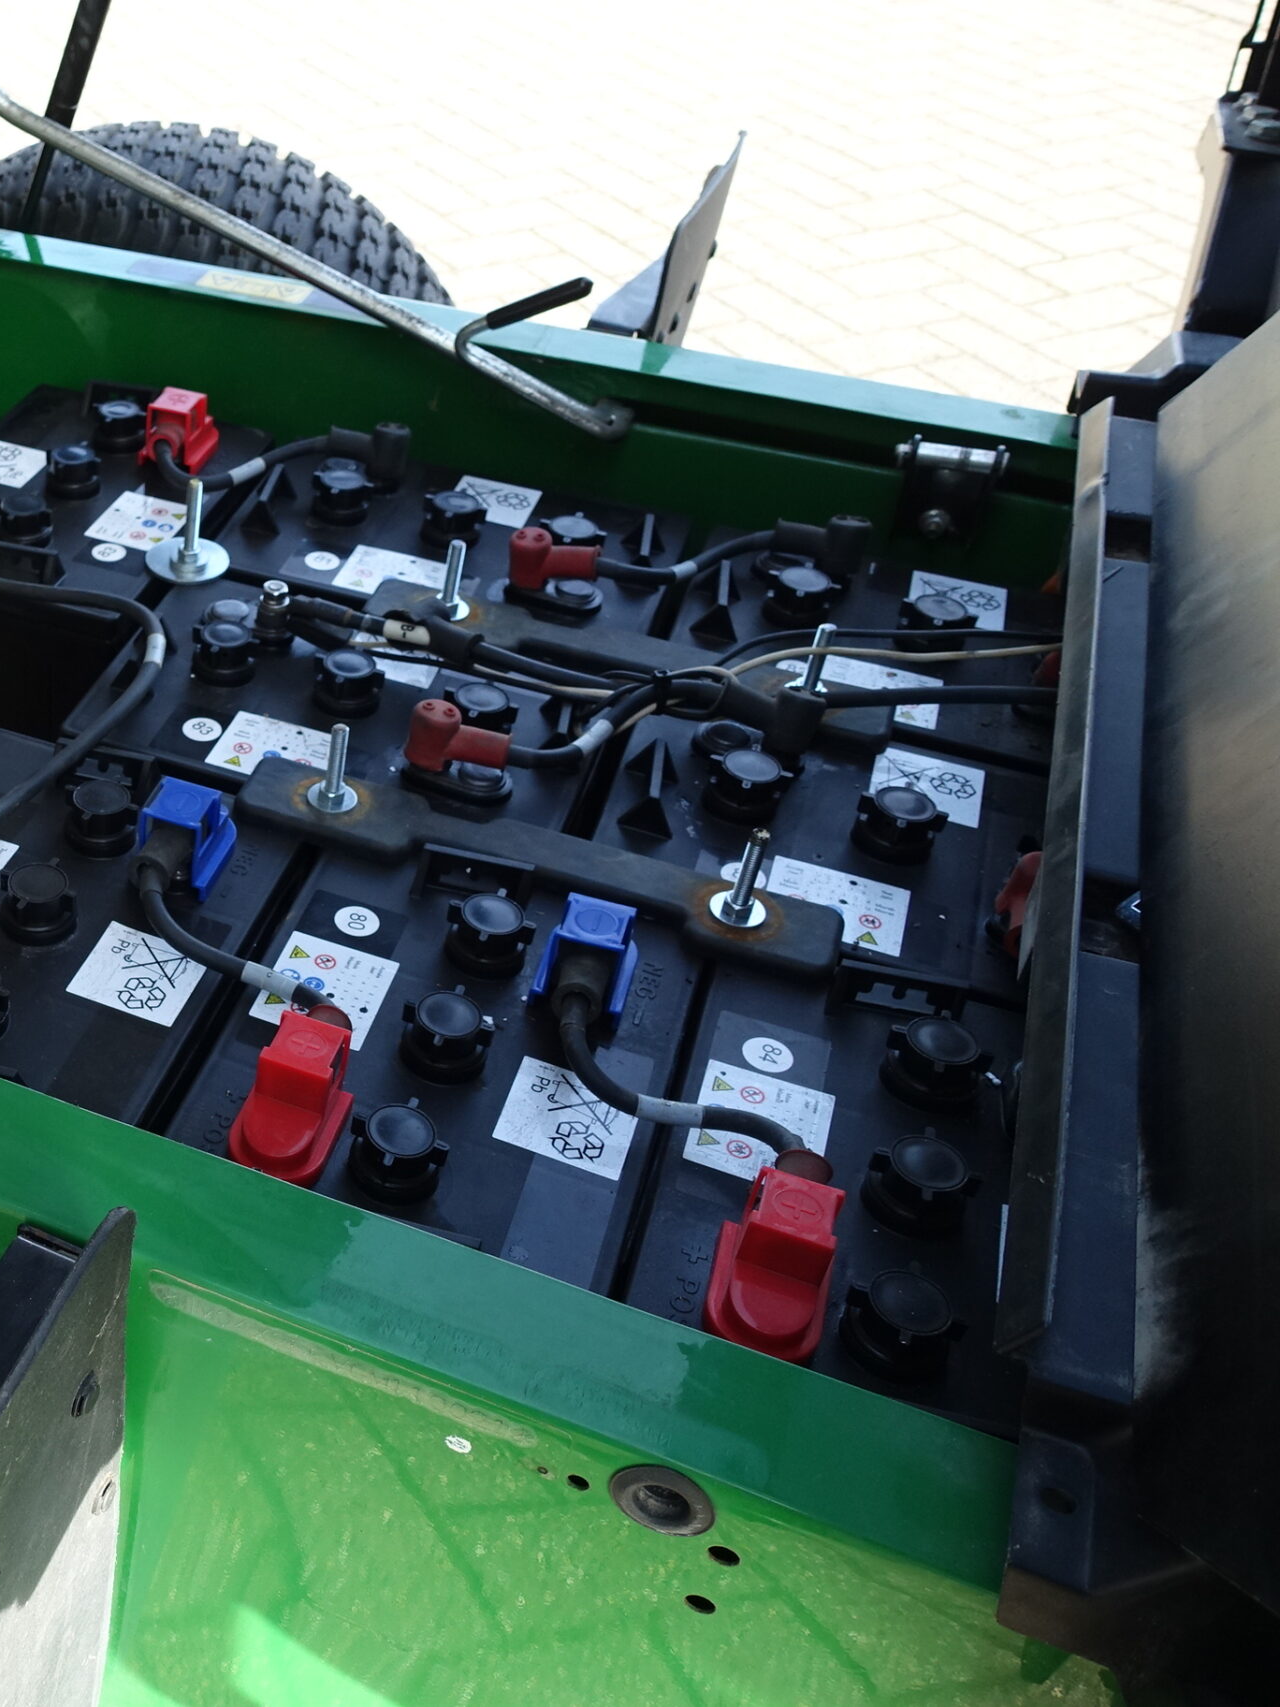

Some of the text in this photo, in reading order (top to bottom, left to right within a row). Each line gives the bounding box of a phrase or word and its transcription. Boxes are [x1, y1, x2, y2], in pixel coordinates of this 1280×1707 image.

[192, 721, 213, 735] 83
[347, 912, 368, 931] 80
[111, 938, 131, 955] Pb
[758, 1043, 783, 1066] 84
[530, 1075, 551, 1093] Pb
